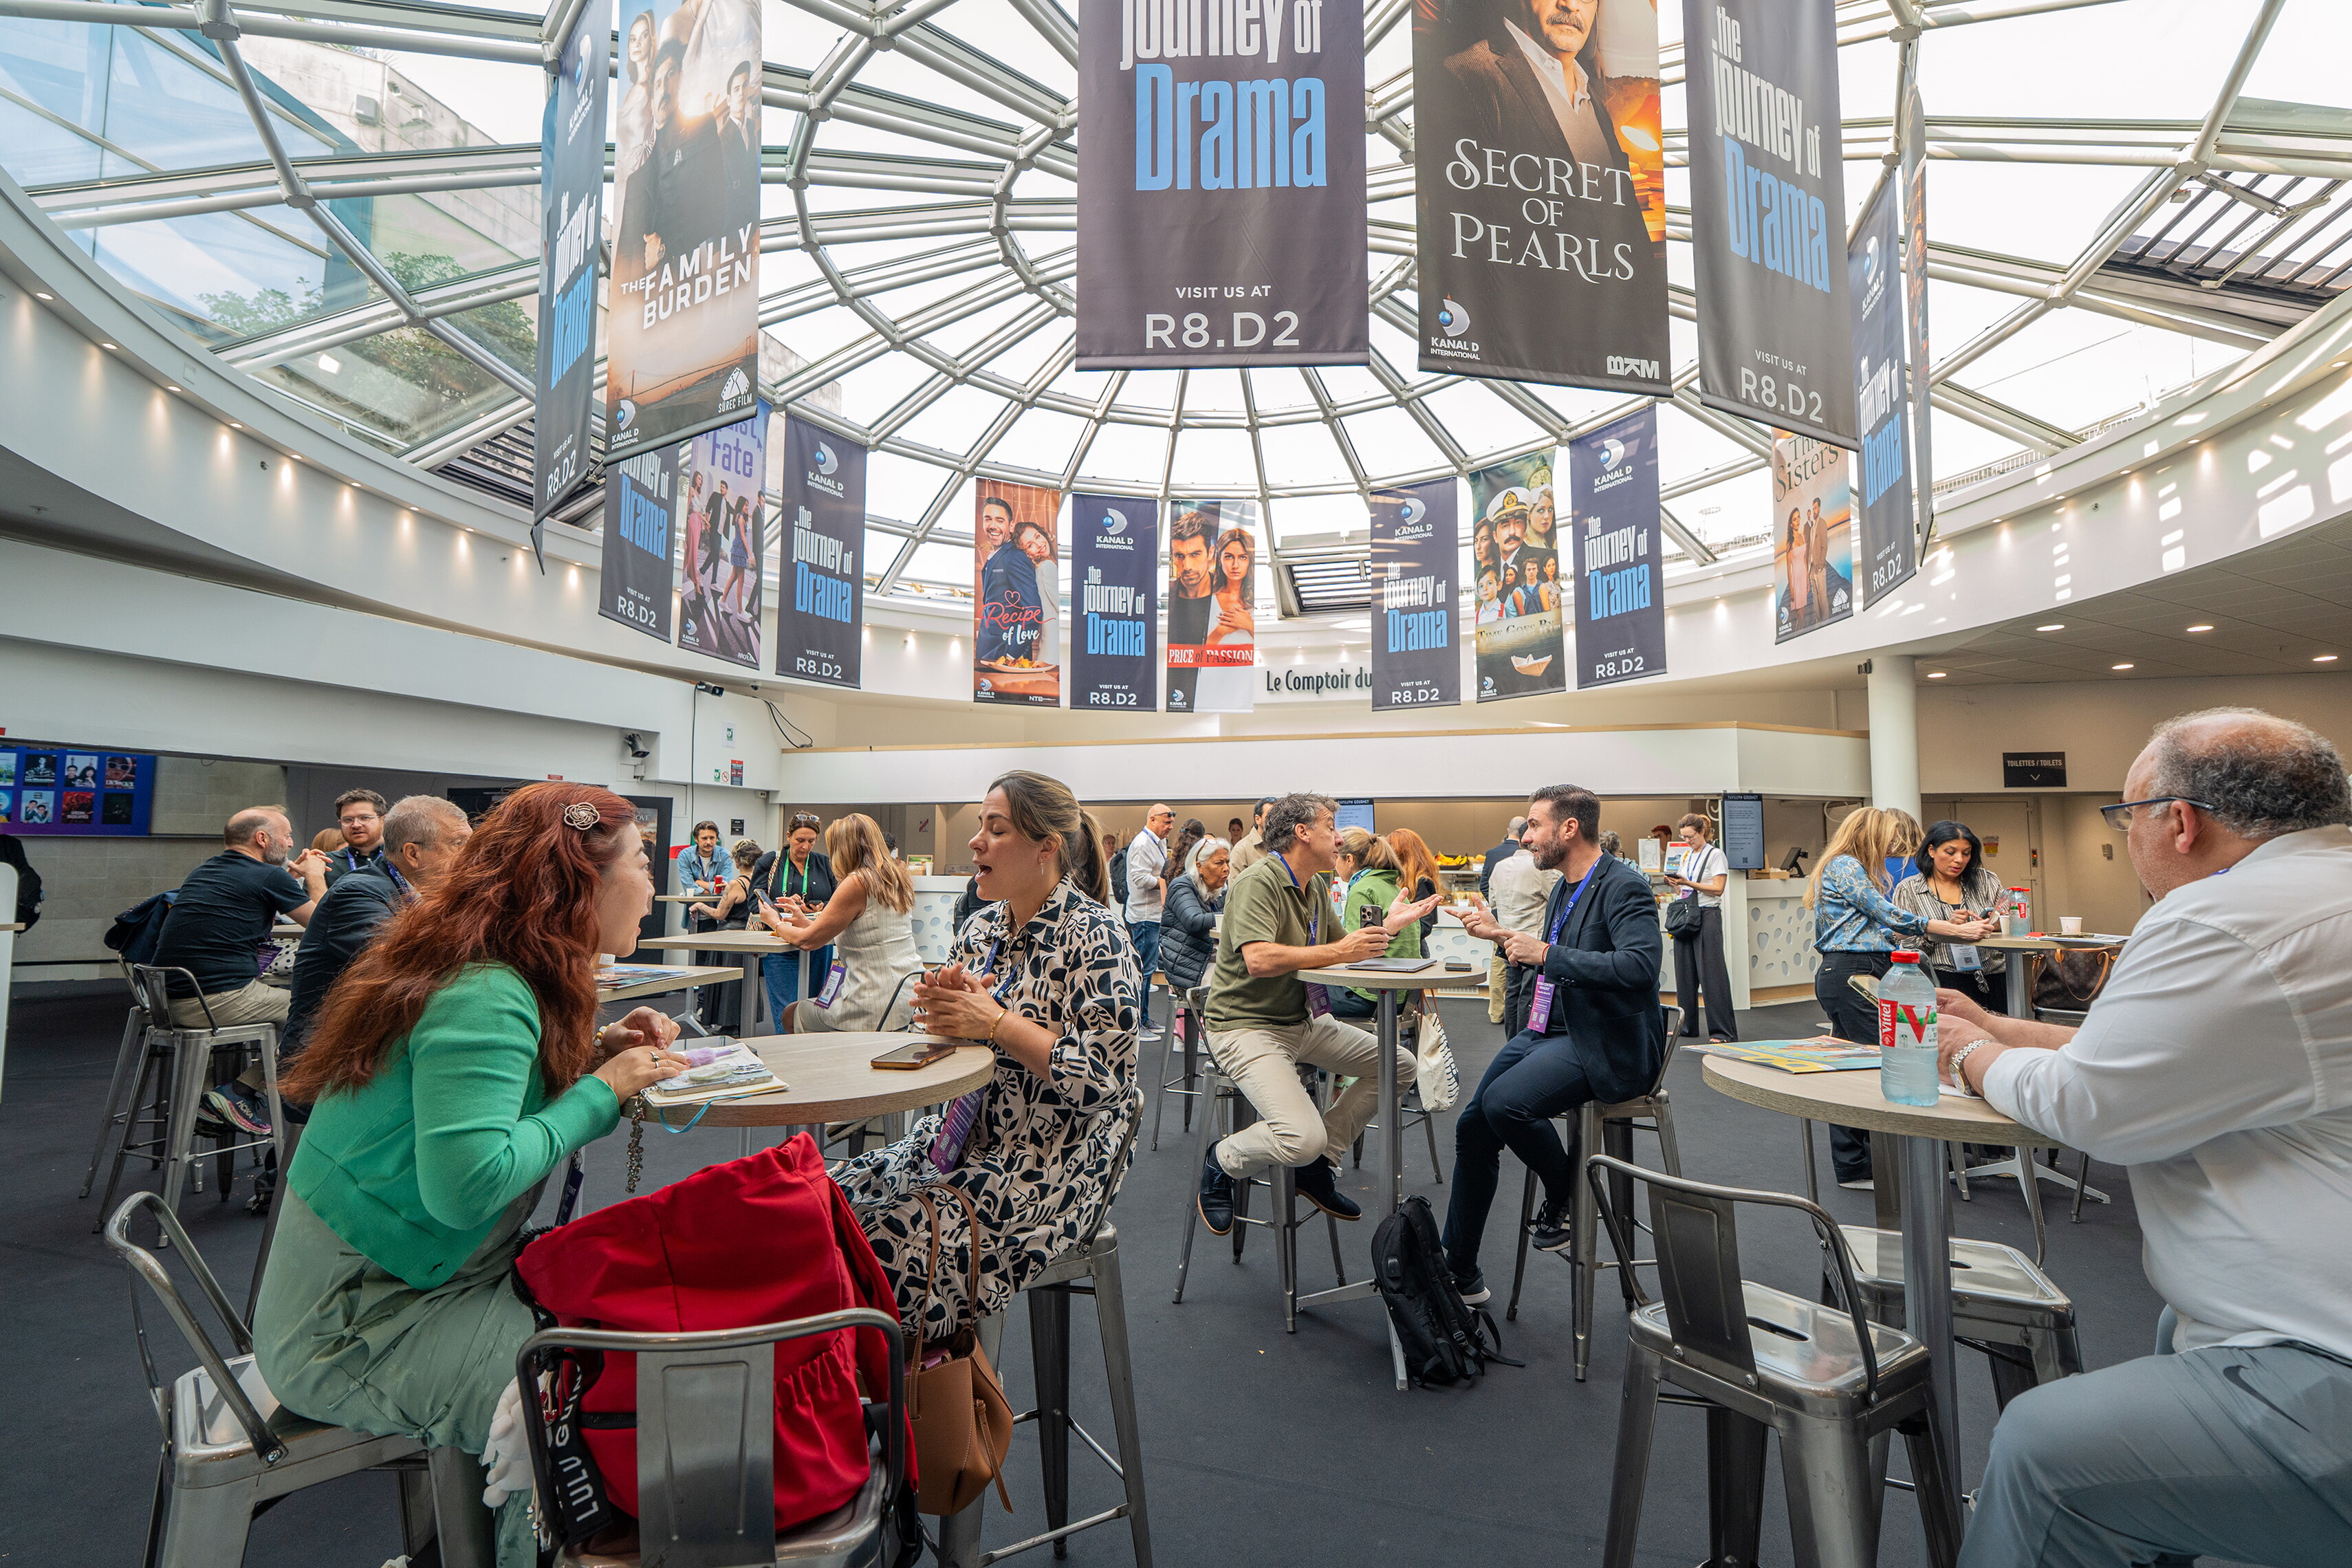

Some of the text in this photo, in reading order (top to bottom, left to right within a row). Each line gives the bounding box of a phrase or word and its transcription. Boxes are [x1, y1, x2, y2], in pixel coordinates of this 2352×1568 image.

[1120, 0, 1322, 70] journey of
[1716, 6, 1742, 63] the
[569, 78, 594, 132] KANAL D
[1712, 38, 1821, 179] journey of
[1135, 63, 1327, 191] Drama
[1446, 138, 1633, 207] SECRET
[1522, 198, 1564, 228] OF
[1724, 137, 1831, 295] Drama
[552, 193, 596, 308] journey of
[621, 222, 752, 301] THE FAMILY
[1450, 213, 1635, 285] PEARLS
[643, 254, 752, 330] BURDEN
[1175, 285, 1272, 299] VISIT US AT
[1862, 280, 1880, 312] KANAL
[551, 264, 592, 391] Drama
[1146, 311, 1300, 349] R8.D2
[1430, 348, 1481, 361] INTERNATIONAL
[1431, 336, 1480, 353] KANAL D
[1755, 349, 1807, 376] VISIT US AT
[1741, 367, 1824, 424] R8.D2
[1859, 357, 1899, 446] journey of
[553, 444, 563, 460] VISIT
[567, 434, 573, 445] AT
[611, 428, 639, 444] KANAL D
[611, 437, 639, 450] INTERNATIONAL
[710, 431, 754, 478] Fate
[1864, 412, 1904, 509] Drama
[547, 449, 577, 501] R8.D2
[660, 470, 669, 501] of
[808, 471, 844, 492] KANAL D
[1593, 475, 1633, 493] INTERNATIONAL
[1594, 466, 1633, 486] KANAL D
[1776, 445, 1839, 503] Sisters
[807, 480, 845, 499] INTERNATIONAL
[620, 473, 668, 561] Drama
[798, 505, 812, 530] the
[1395, 523, 1433, 536] KANAL D
[1588, 515, 1601, 538] the
[792, 521, 853, 575] journey of
[1096, 535, 1126, 545] KANAL
[1394, 532, 1433, 543] INTERNATIONAL
[1585, 524, 1648, 577] journey of
[1876, 547, 1886, 562] VISIT
[1891, 541, 1896, 551] AT
[1088, 565, 1102, 585] the
[1388, 561, 1400, 580] the
[1873, 553, 1902, 593] R8.D2
[627, 587, 651, 603] VISIT US AT
[795, 560, 852, 624] Drama
[1082, 579, 1145, 617] journey of
[1383, 575, 1446, 614] journey of
[1590, 563, 1651, 621] Drama
[618, 595, 656, 629] R8.D2
[977, 602, 1057, 631] Recipe
[682, 633, 695, 642] KANAL
[1002, 624, 1041, 646] of Love
[1087, 612, 1146, 657] Drama
[1388, 609, 1448, 653] Drama
[1477, 629, 1503, 640] TIME
[1505, 624, 1535, 633] GOES
[796, 657, 842, 679] R8.D2
[806, 649, 820, 657] VISIT
[1168, 649, 1253, 664] PRICE of PASSION
[1596, 656, 1644, 679] R8.D2
[1604, 651, 1618, 659] VISIT
[1267, 666, 1372, 694] Le Comptoir du
[1089, 692, 1137, 706] R8.D2
[1391, 688, 1439, 704] R8.D2
[1881, 1003, 1892, 1033] Vittel
[236, 1100, 254, 1119] HOKA
[558, 1456, 600, 1523] LULU
